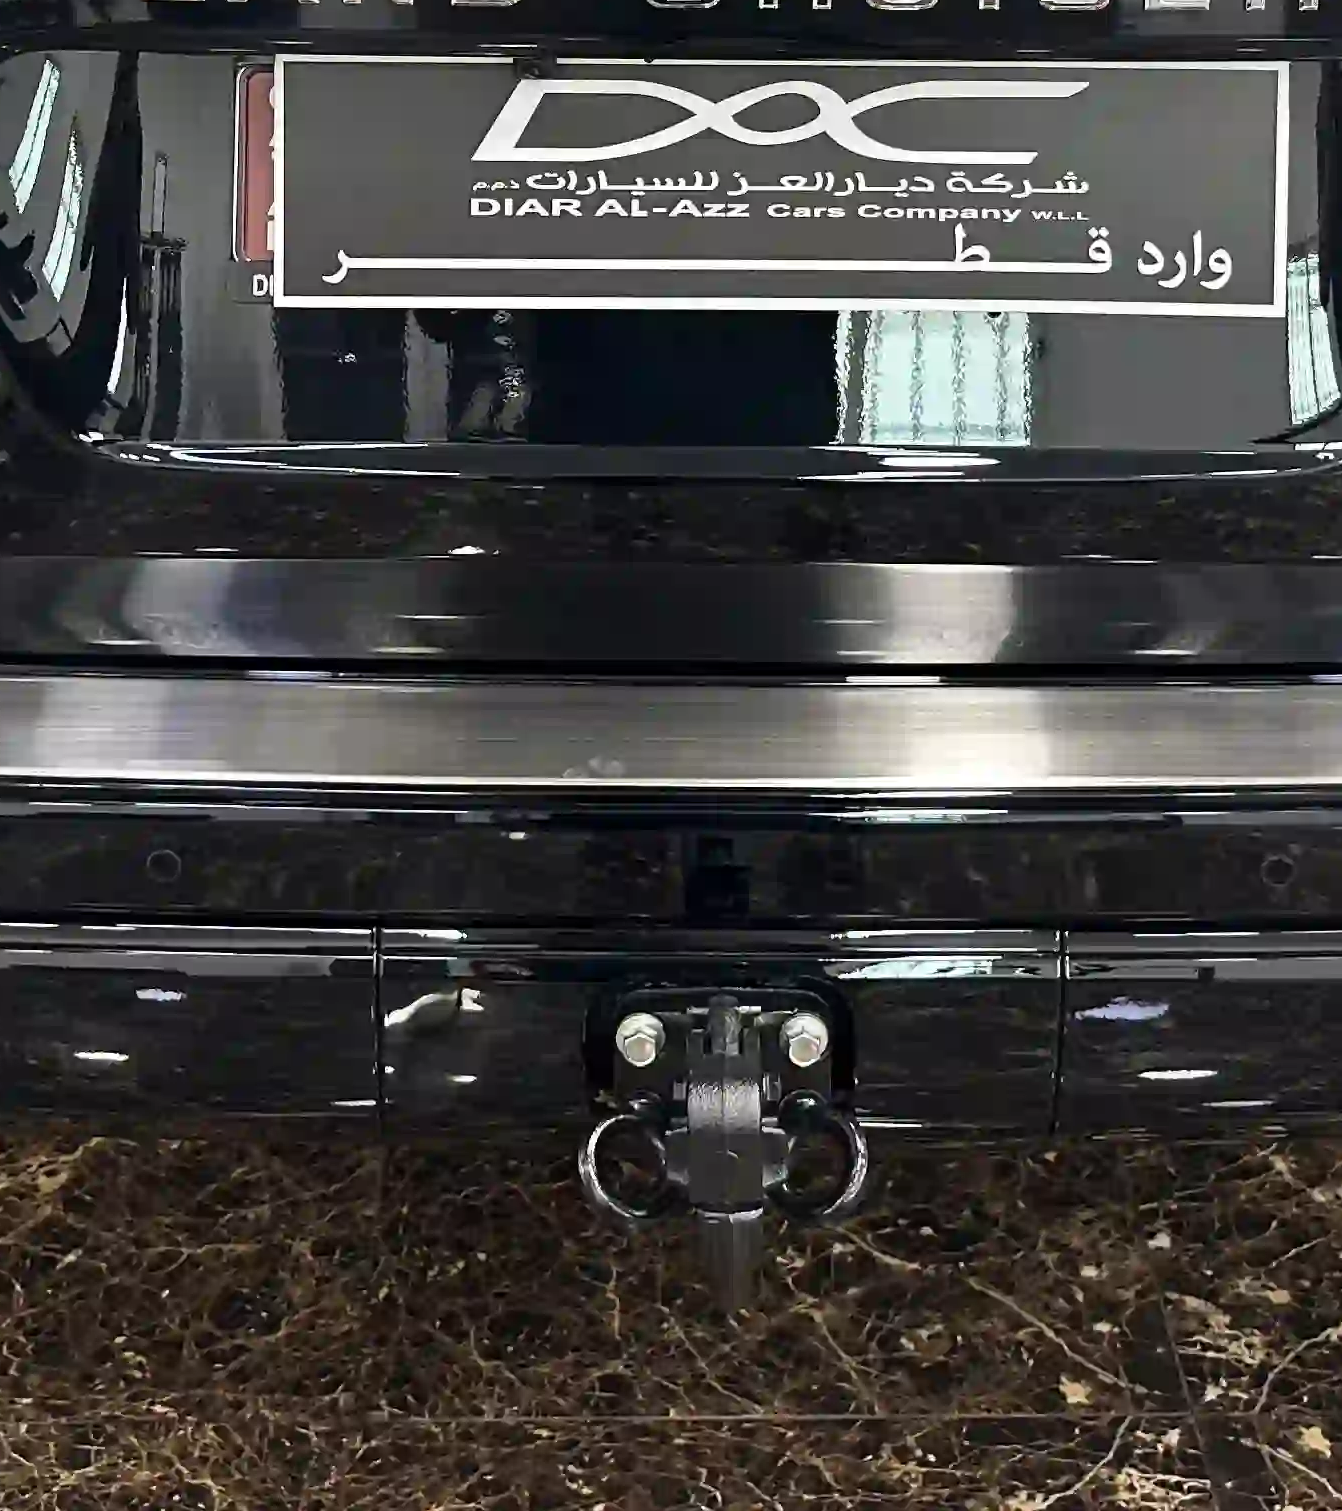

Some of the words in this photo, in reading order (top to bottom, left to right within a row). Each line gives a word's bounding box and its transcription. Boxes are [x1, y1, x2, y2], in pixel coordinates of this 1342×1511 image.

[525, 169, 721, 197] للسيارات
[725, 170, 836, 197] العز
[831, 170, 936, 198] ديار
[944, 170, 1090, 199] شركة
[469, 196, 584, 218] DIAR
[766, 203, 847, 219] Cars
[857, 203, 1022, 223] Company
[1136, 228, 1234, 291] وارد
